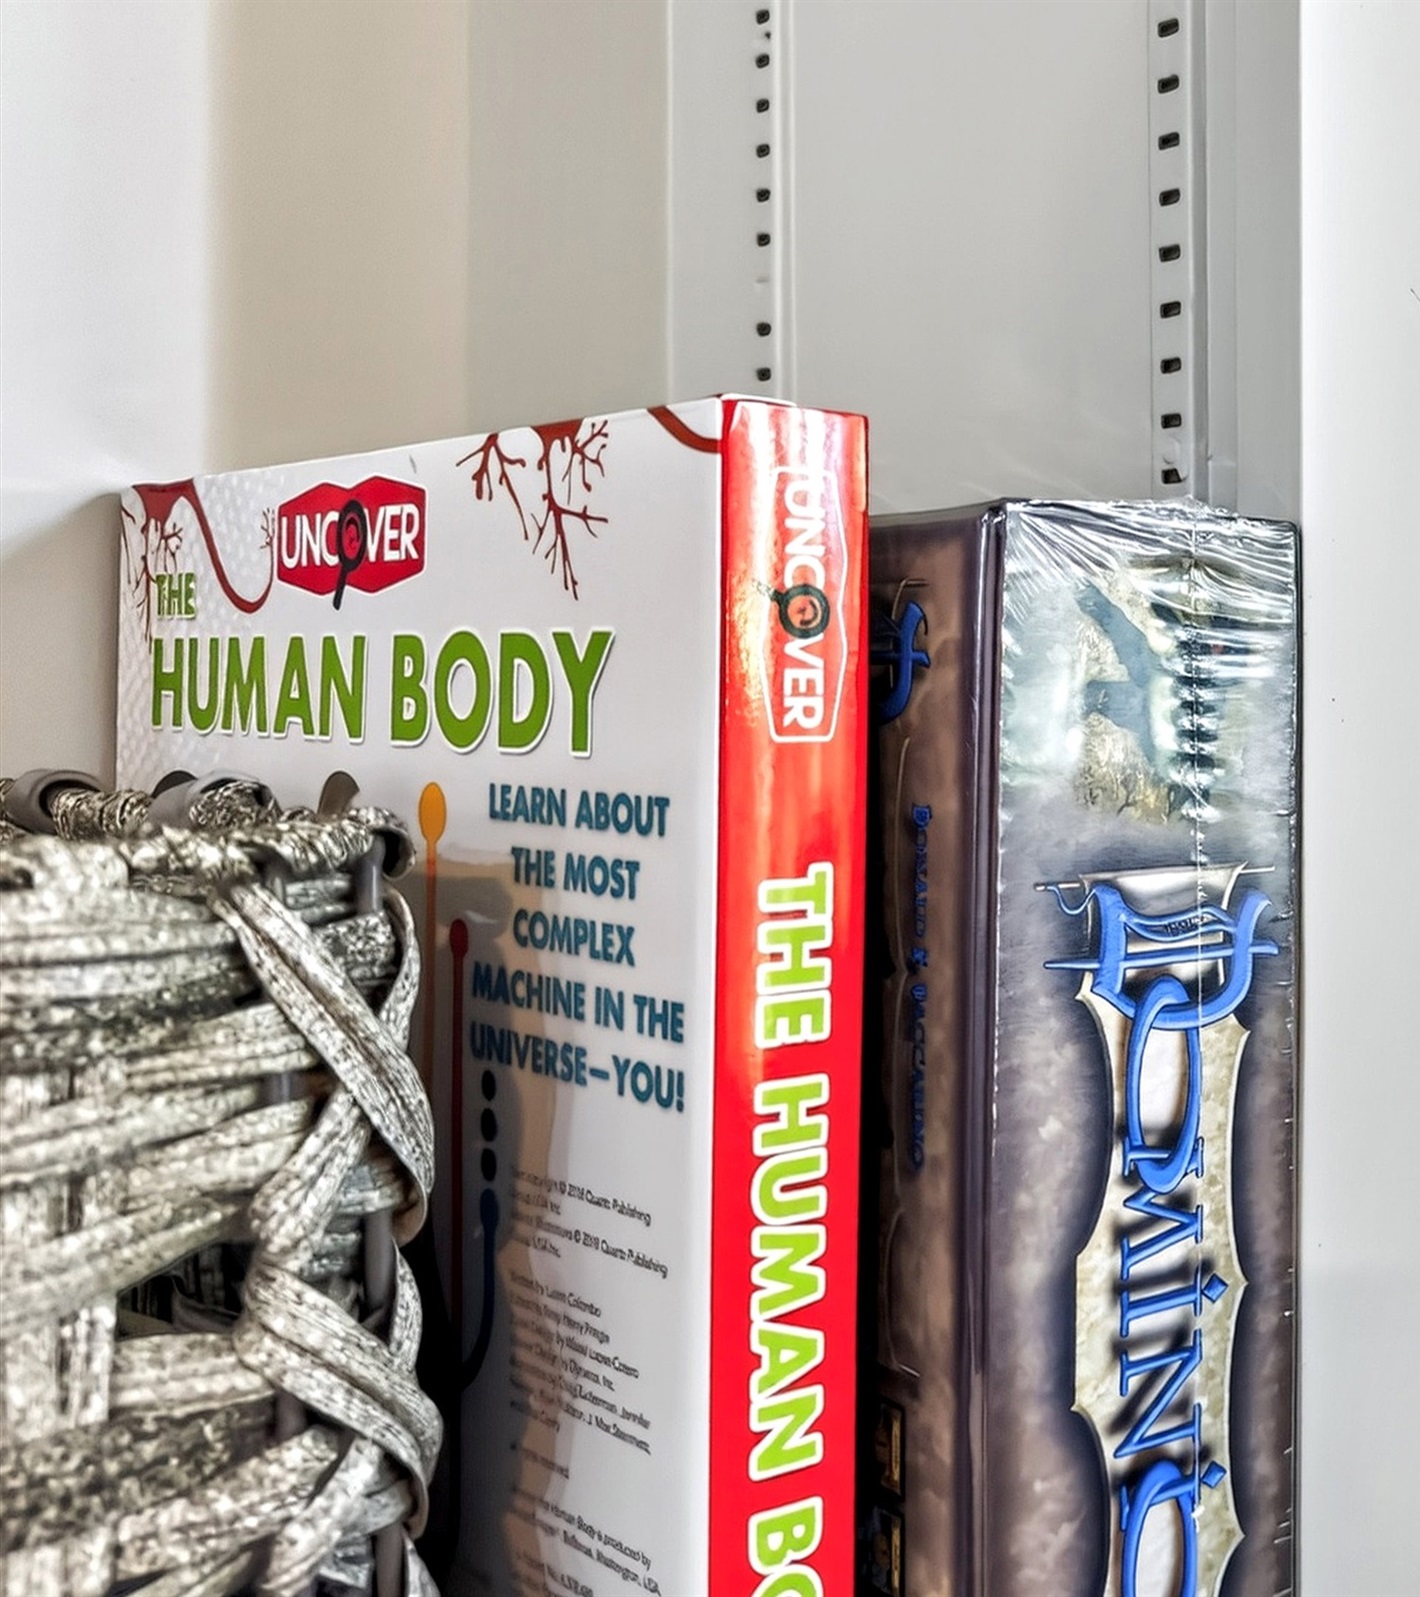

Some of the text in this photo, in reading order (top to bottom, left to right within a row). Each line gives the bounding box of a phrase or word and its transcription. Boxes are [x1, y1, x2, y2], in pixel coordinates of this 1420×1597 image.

[279, 502, 421, 569] UNCOVER
[155, 573, 197, 619] THE
[783, 470, 828, 730] UNCOVER
[151, 627, 615, 760] HUMAN BODY
[488, 783, 671, 838] LEARN ABOUT
[511, 846, 640, 900] THE MOST
[512, 908, 636, 967] COMPLEX
[756, 862, 836, 1051] THE
[472, 960, 686, 1044] MACHINE IN THE
[748, 1074, 830, 1483] HUMAN
